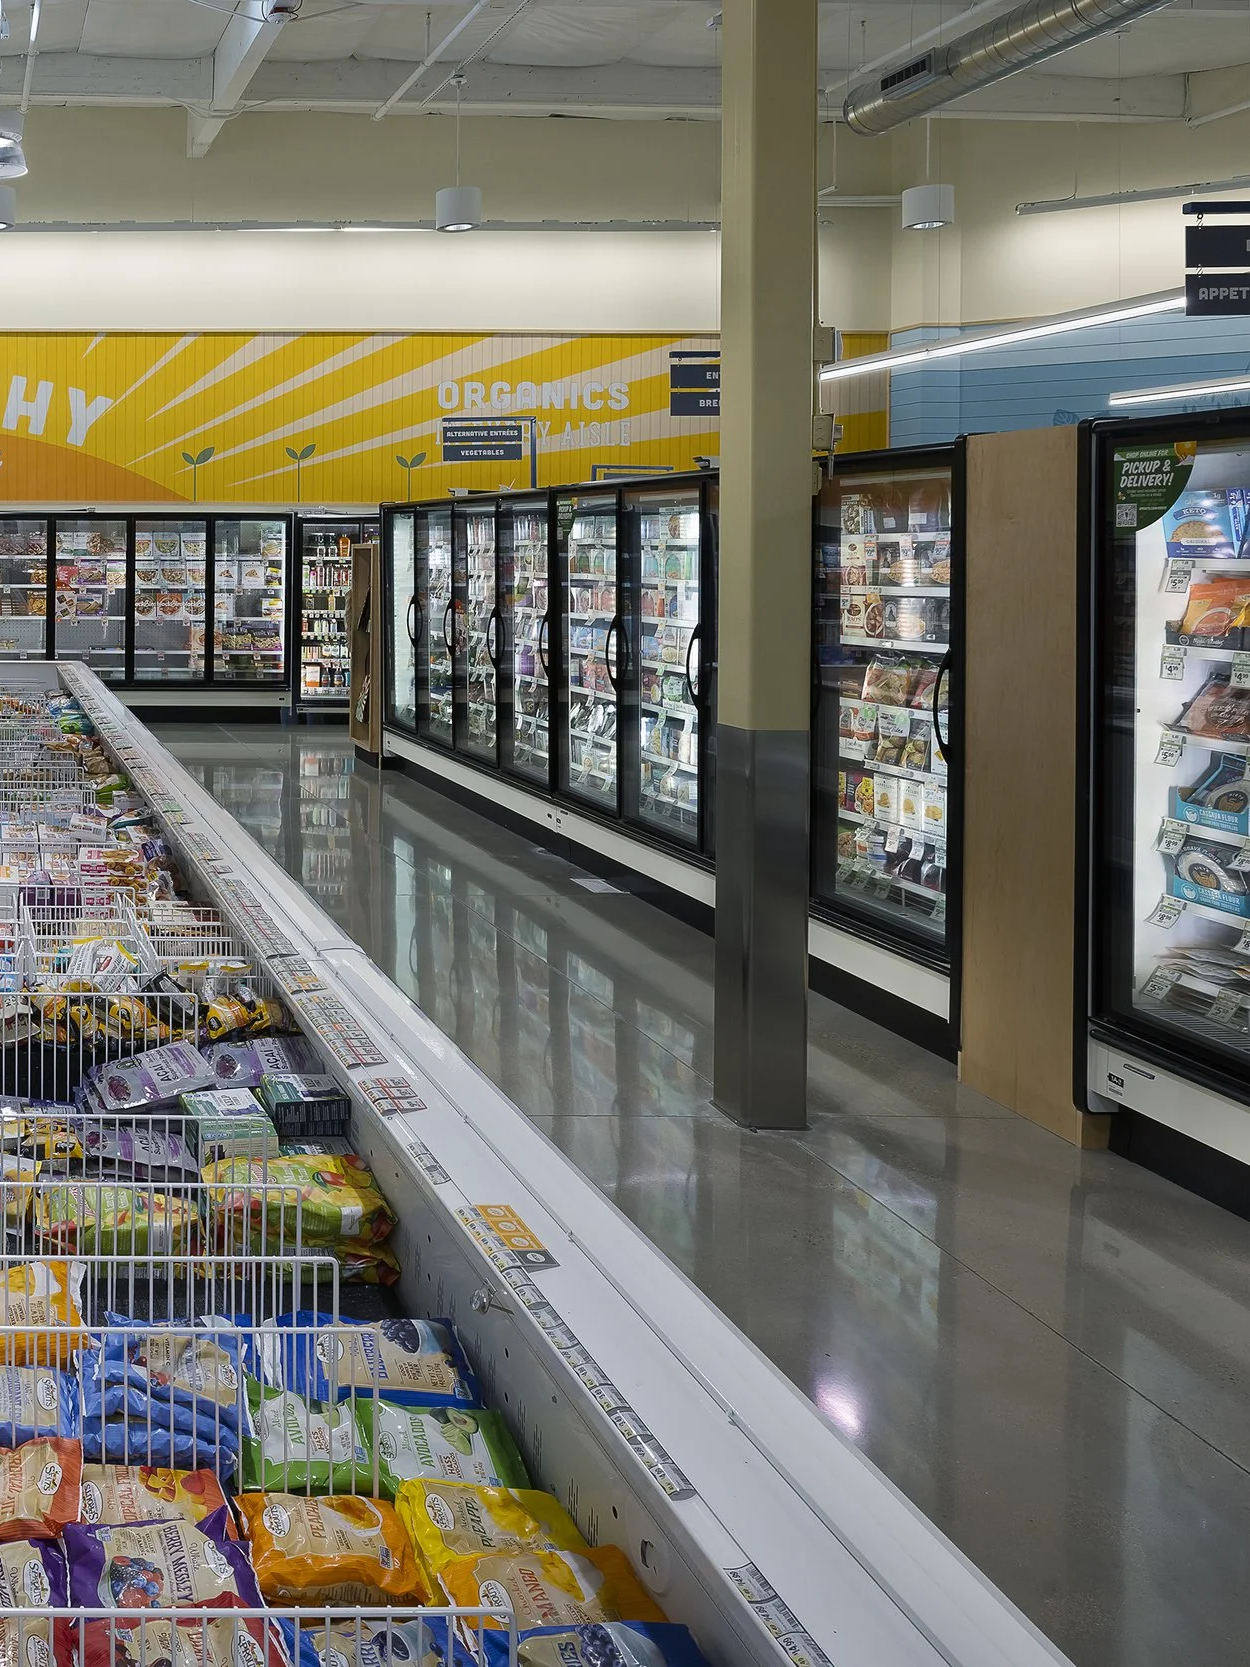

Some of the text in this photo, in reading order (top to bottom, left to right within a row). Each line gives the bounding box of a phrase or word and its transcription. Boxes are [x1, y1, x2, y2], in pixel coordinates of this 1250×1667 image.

[437, 380, 630, 410] ORGANICS
[561, 420, 631, 446] AISLE
[1157, 449, 1169, 457] FOR
[1119, 472, 1175, 488] DELIVERY!
[1121, 459, 1171, 475] PICKUP &
[1221, 814, 1239, 824] FLOUR
[1222, 893, 1240, 905] FLOUR
[42, 1380, 52, 1407] SPROUTS
[401, 1430, 412, 1450] Sliced
[445, 1456, 455, 1474] HASS
[85, 1484, 98, 1520] SPROUTS
[431, 1497, 451, 1529] SPROUTS
[271, 1506, 285, 1535] SPROUTS
[304, 1498, 327, 1538] PEACHES
[162, 1524, 184, 1556] BERRY
[28, 1560, 44, 1604] SPROUTS
[519, 1567, 551, 1619] MANGO
[485, 1582, 507, 1619] SROUTS
[783, 1637, 800, 1656] 14.99
